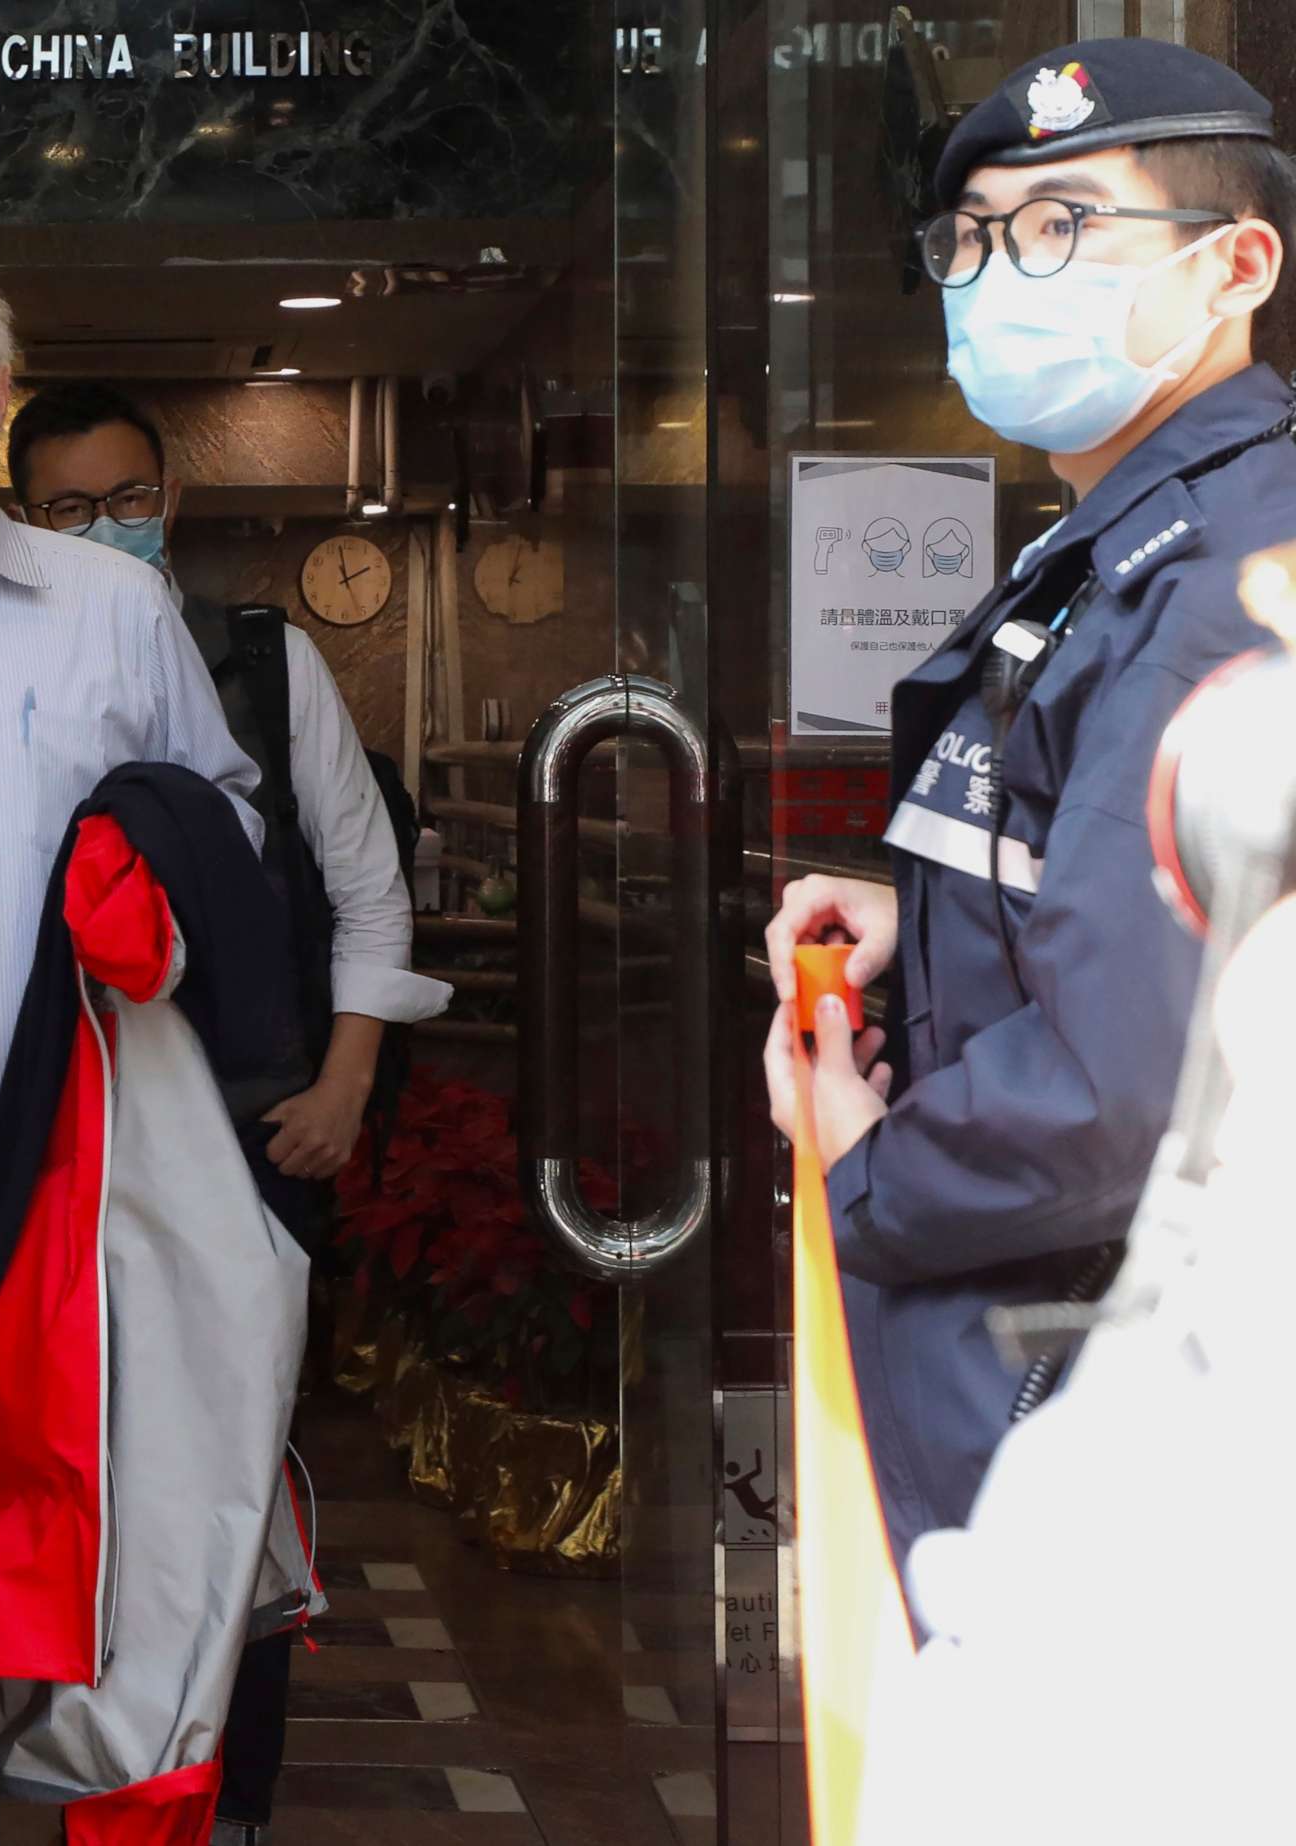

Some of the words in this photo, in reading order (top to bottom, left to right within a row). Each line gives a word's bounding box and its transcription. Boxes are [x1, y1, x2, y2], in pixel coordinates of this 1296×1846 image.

[1, 33, 135, 81] CHINA
[173, 31, 373, 80] BUILDING
[935, 731, 993, 774] OLIC
